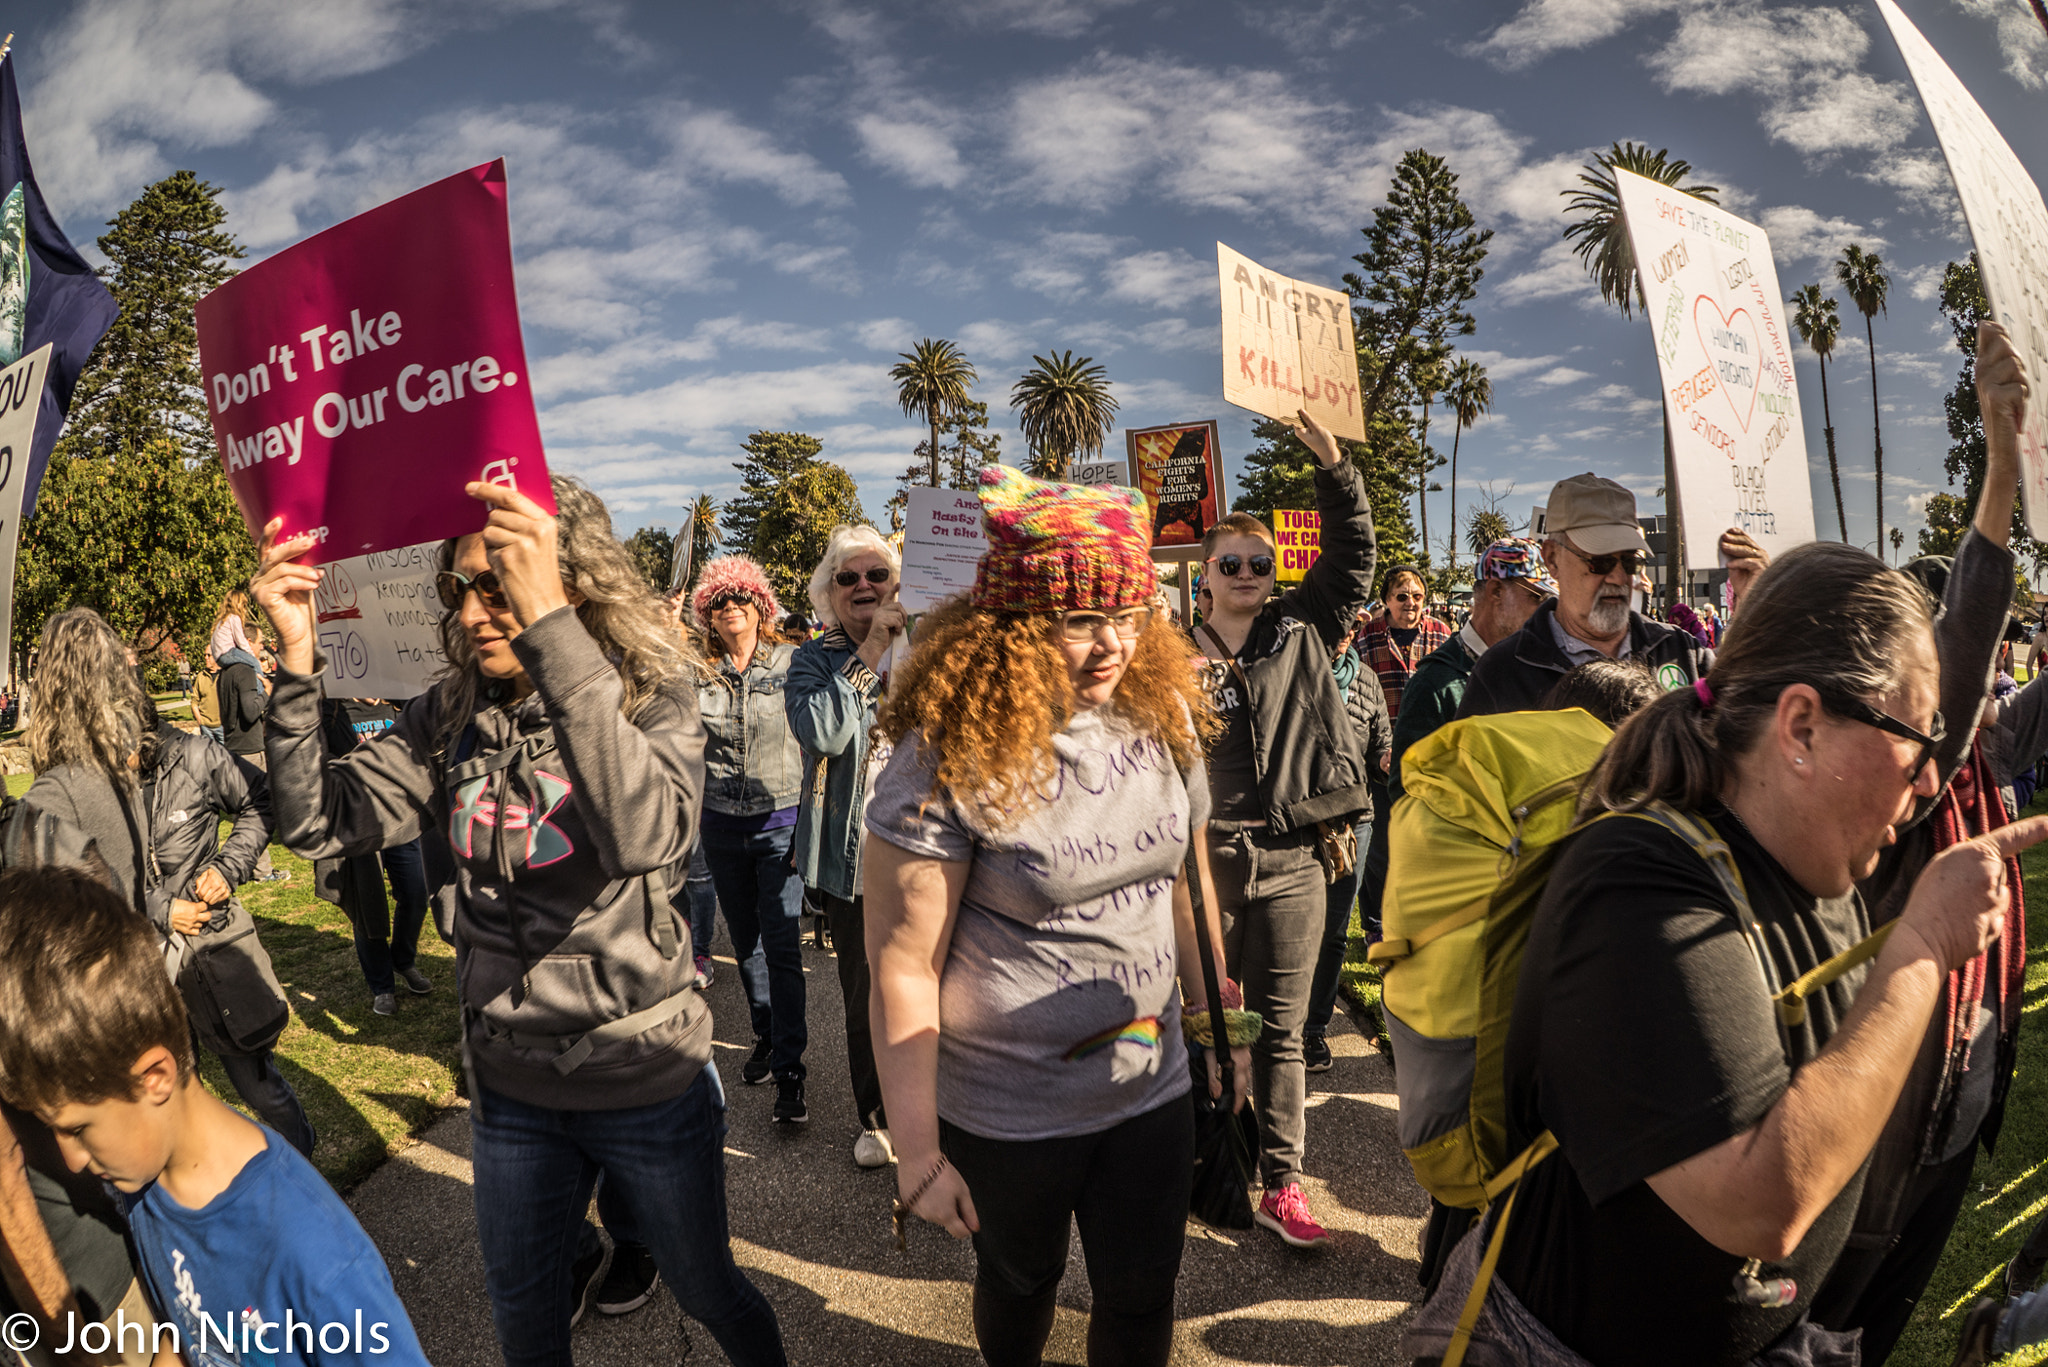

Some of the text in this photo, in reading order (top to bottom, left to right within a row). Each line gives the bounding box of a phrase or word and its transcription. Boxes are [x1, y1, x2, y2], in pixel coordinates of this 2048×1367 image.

[1687, 210, 1711, 237] THE
[1713, 220, 1751, 253] PLANET
[1651, 238, 1691, 284] WOMEN
[1233, 262, 1345, 325] ANGRY
[1711, 328, 1748, 355] HUMAN
[212, 308, 402, 415] Don't Take
[1718, 359, 1753, 389] RIGHTS
[226, 355, 518, 474] Away Our Care.
[1689, 410, 1736, 460] SENIORS
[1072, 464, 1118, 481] HOPE
[1144, 455, 1206, 469] CALIFORNIA
[1157, 465, 1196, 478] FIGHTS
[1155, 483, 1201, 495] WOMEN'S
[1167, 475, 1187, 486] FOR
[1732, 464, 1766, 489] BLACK
[1159, 492, 1199, 504] RIGHTS
[1738, 488, 1768, 513] LIVES
[931, 525, 949, 536] On
[953, 527, 978, 539] the
[1734, 512, 1777, 535] MATTER
[1276, 531, 1320, 546] WE CA
[1283, 549, 1319, 569] CHA
[313, 563, 358, 613] NO
[320, 631, 368, 679] TO
[394, 640, 450, 664] Hate
[1135, 812, 1183, 852] are
